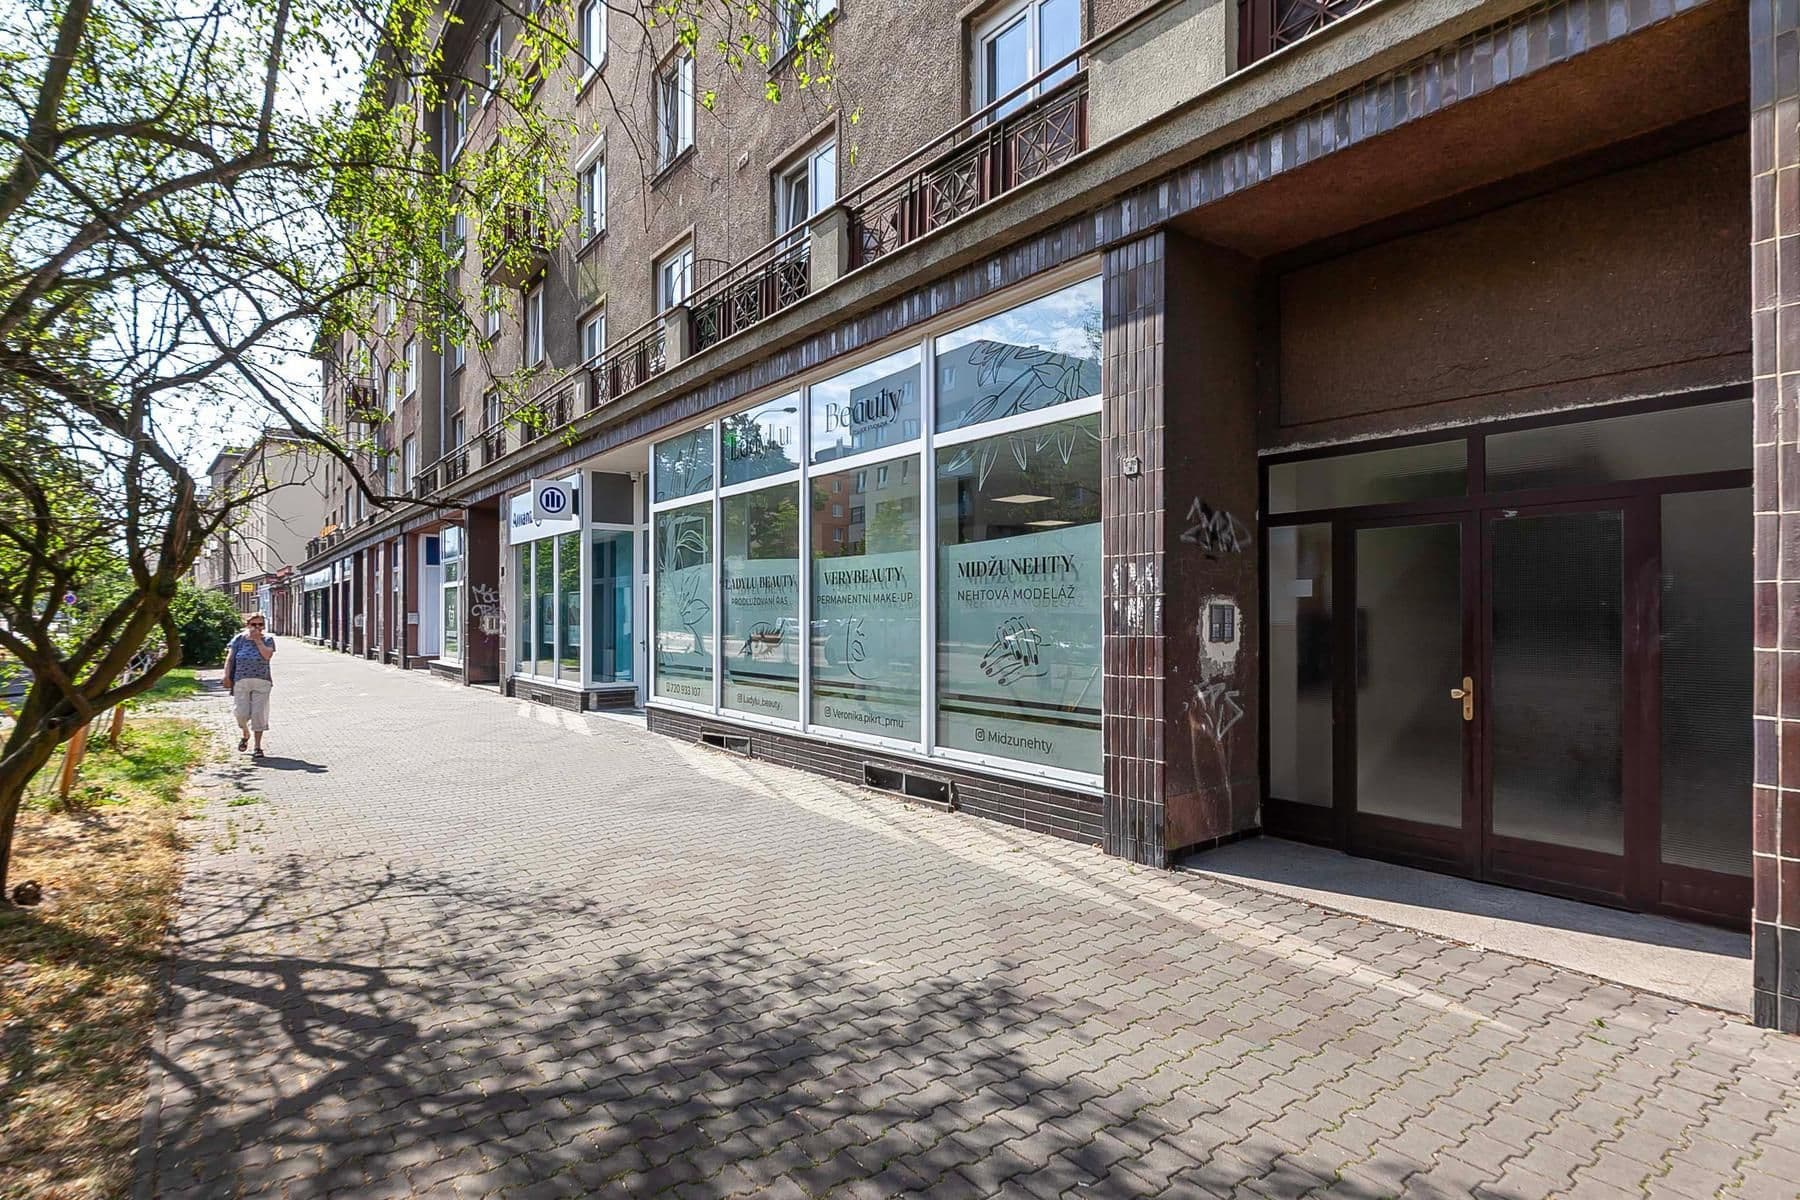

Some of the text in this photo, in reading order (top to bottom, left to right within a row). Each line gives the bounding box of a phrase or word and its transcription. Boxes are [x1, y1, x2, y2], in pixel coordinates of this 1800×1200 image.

[825, 387, 903, 433] Beauty
[824, 566, 903, 585] VERYBEAUTY
[958, 554, 1075, 578] MIDŽUNEHTY
[759, 574, 794, 589] BEAUTY
[816, 591, 913, 605] PERMANENTNÍ MAKE-UP
[957, 584, 1075, 601] NEHTOVÁ MODELÁŽ
[988, 731, 1053, 753] Midzunehty
